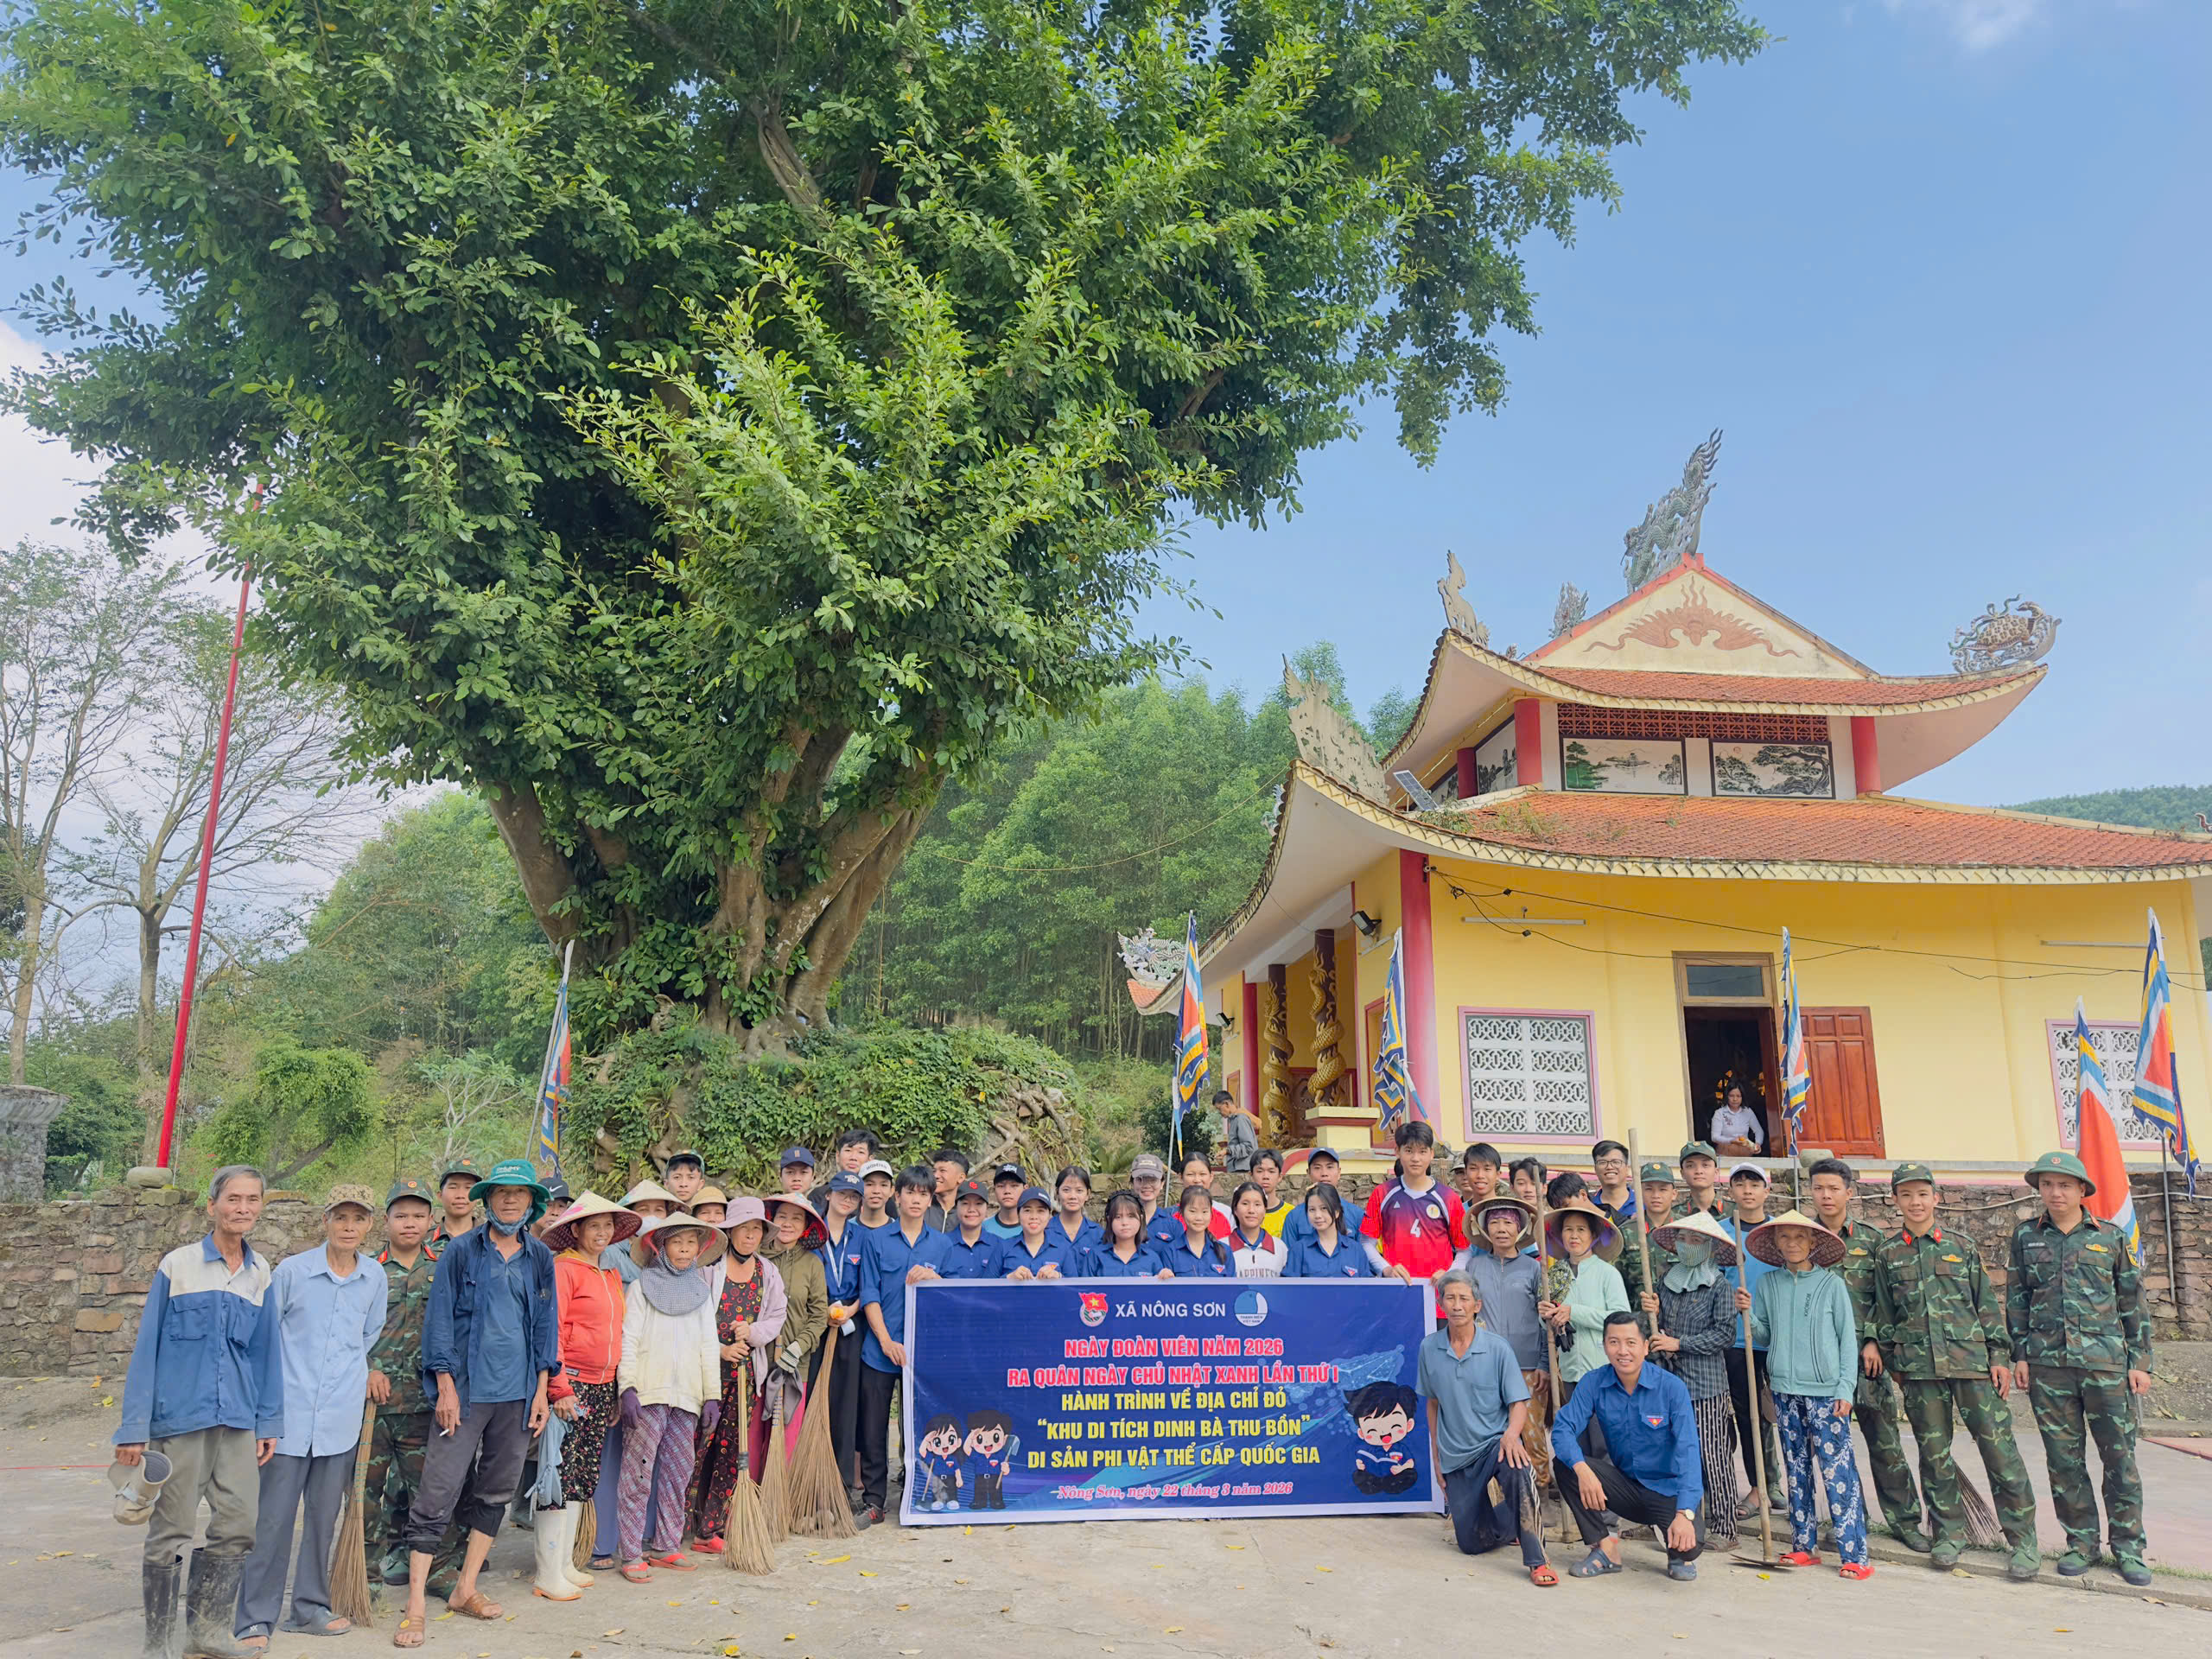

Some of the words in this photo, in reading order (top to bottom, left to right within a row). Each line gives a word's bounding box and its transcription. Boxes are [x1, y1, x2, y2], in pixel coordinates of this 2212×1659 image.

[1409, 1218, 1421, 1238] 4
[1115, 1301, 1135, 1318] XÃ
[1141, 1300, 1188, 1317] NÔNG
[1192, 1302, 1226, 1317] SƠN
[1065, 1336, 1109, 1357] NGÀY
[1112, 1335, 1158, 1357] ĐOÀN
[1160, 1335, 1199, 1357] VIÊN
[1203, 1335, 1241, 1356] NĂM
[1244, 1338, 1284, 1356] 2026
[1007, 1368, 1031, 1387] RA
[1033, 1364, 1080, 1389] QUÂN
[1084, 1363, 1128, 1386] NGÀY
[1132, 1361, 1166, 1386] CHỦ
[1168, 1363, 1211, 1388] NHẬT
[1215, 1365, 1260, 1384] XANH
[1262, 1360, 1295, 1383] LẦN
[1298, 1362, 1331, 1383] THỨ
[1332, 1365, 1339, 1383] I
[1061, 1390, 1109, 1411] HÀNH
[1115, 1389, 1166, 1410] TRÌNH
[1170, 1387, 1192, 1409] VỀ
[1196, 1391, 1225, 1412] ĐỊA
[1230, 1386, 1259, 1408] CHỈ
[1263, 1386, 1287, 1408] ĐỎ
[1087, 1421, 1105, 1439] DI
[1109, 1418, 1148, 1438] TÍCH
[1154, 1420, 1195, 1438] DINH
[1200, 1416, 1224, 1437] BÀ
[1228, 1420, 1261, 1436] THU
[1027, 1451, 1046, 1469] DI
[1051, 1445, 1088, 1468] SẢN
[1092, 1450, 1122, 1467] PHI
[1127, 1446, 1159, 1471] VẬT
[1163, 1442, 1196, 1465] THỂ
[1200, 1441, 1235, 1465] CẤP
[1240, 1440, 1287, 1466] QUỐC
[1291, 1446, 1320, 1464] GIA
[1057, 1484, 1094, 1500] Nông
[1095, 1484, 1125, 1499] Sơn,
[1127, 1484, 1161, 1499] ngày
[1161, 1484, 1179, 1497] 22
[1180, 1482, 1220, 1497] tháng
[1221, 1484, 1230, 1496] 3
[1231, 1483, 1262, 1496] năm
[1262, 1481, 1294, 1495] 2026
